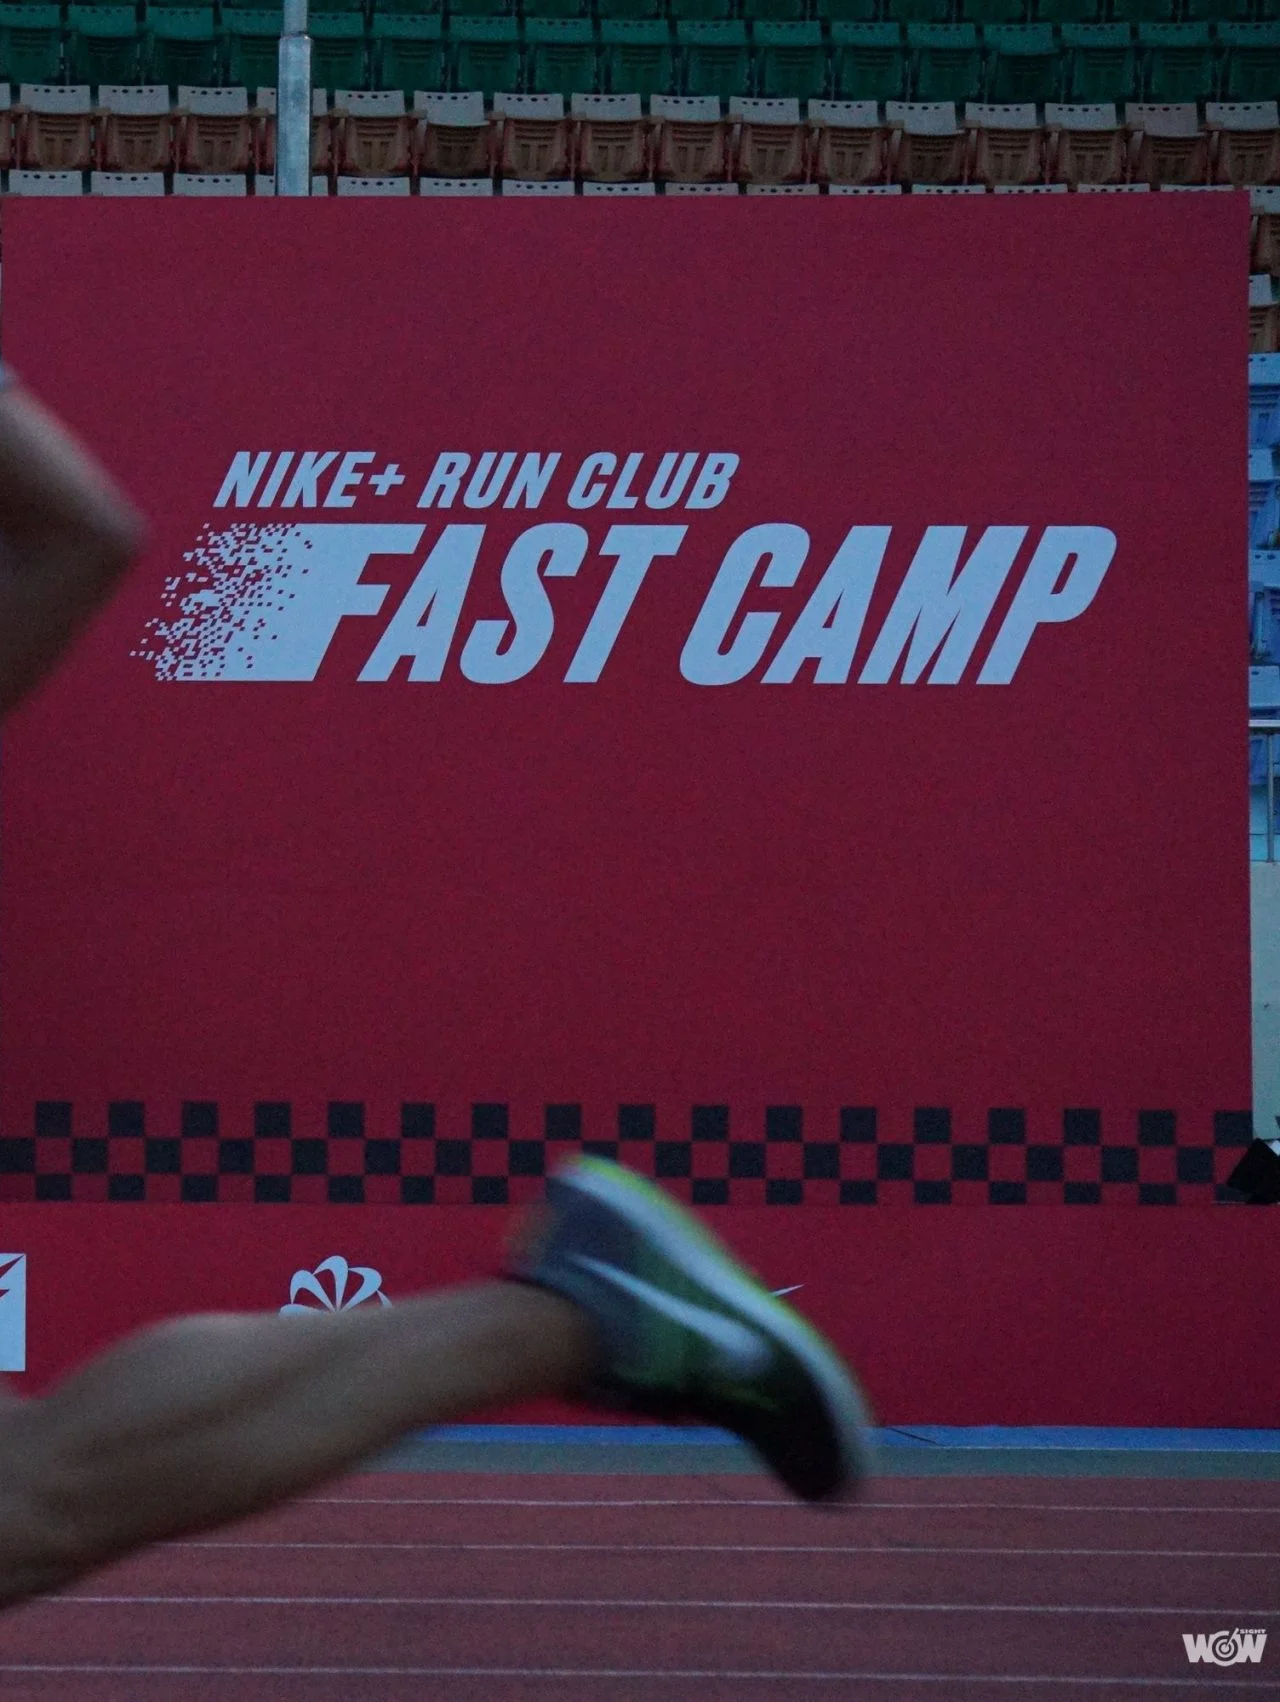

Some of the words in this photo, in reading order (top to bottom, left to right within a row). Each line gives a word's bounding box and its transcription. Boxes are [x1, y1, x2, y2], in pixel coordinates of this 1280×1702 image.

[213, 451, 406, 509] NIKE+
[417, 451, 562, 509] RUN
[567, 451, 740, 510] CLUB
[200, 522, 689, 685] FAST
[680, 522, 1117, 686] CAMP
